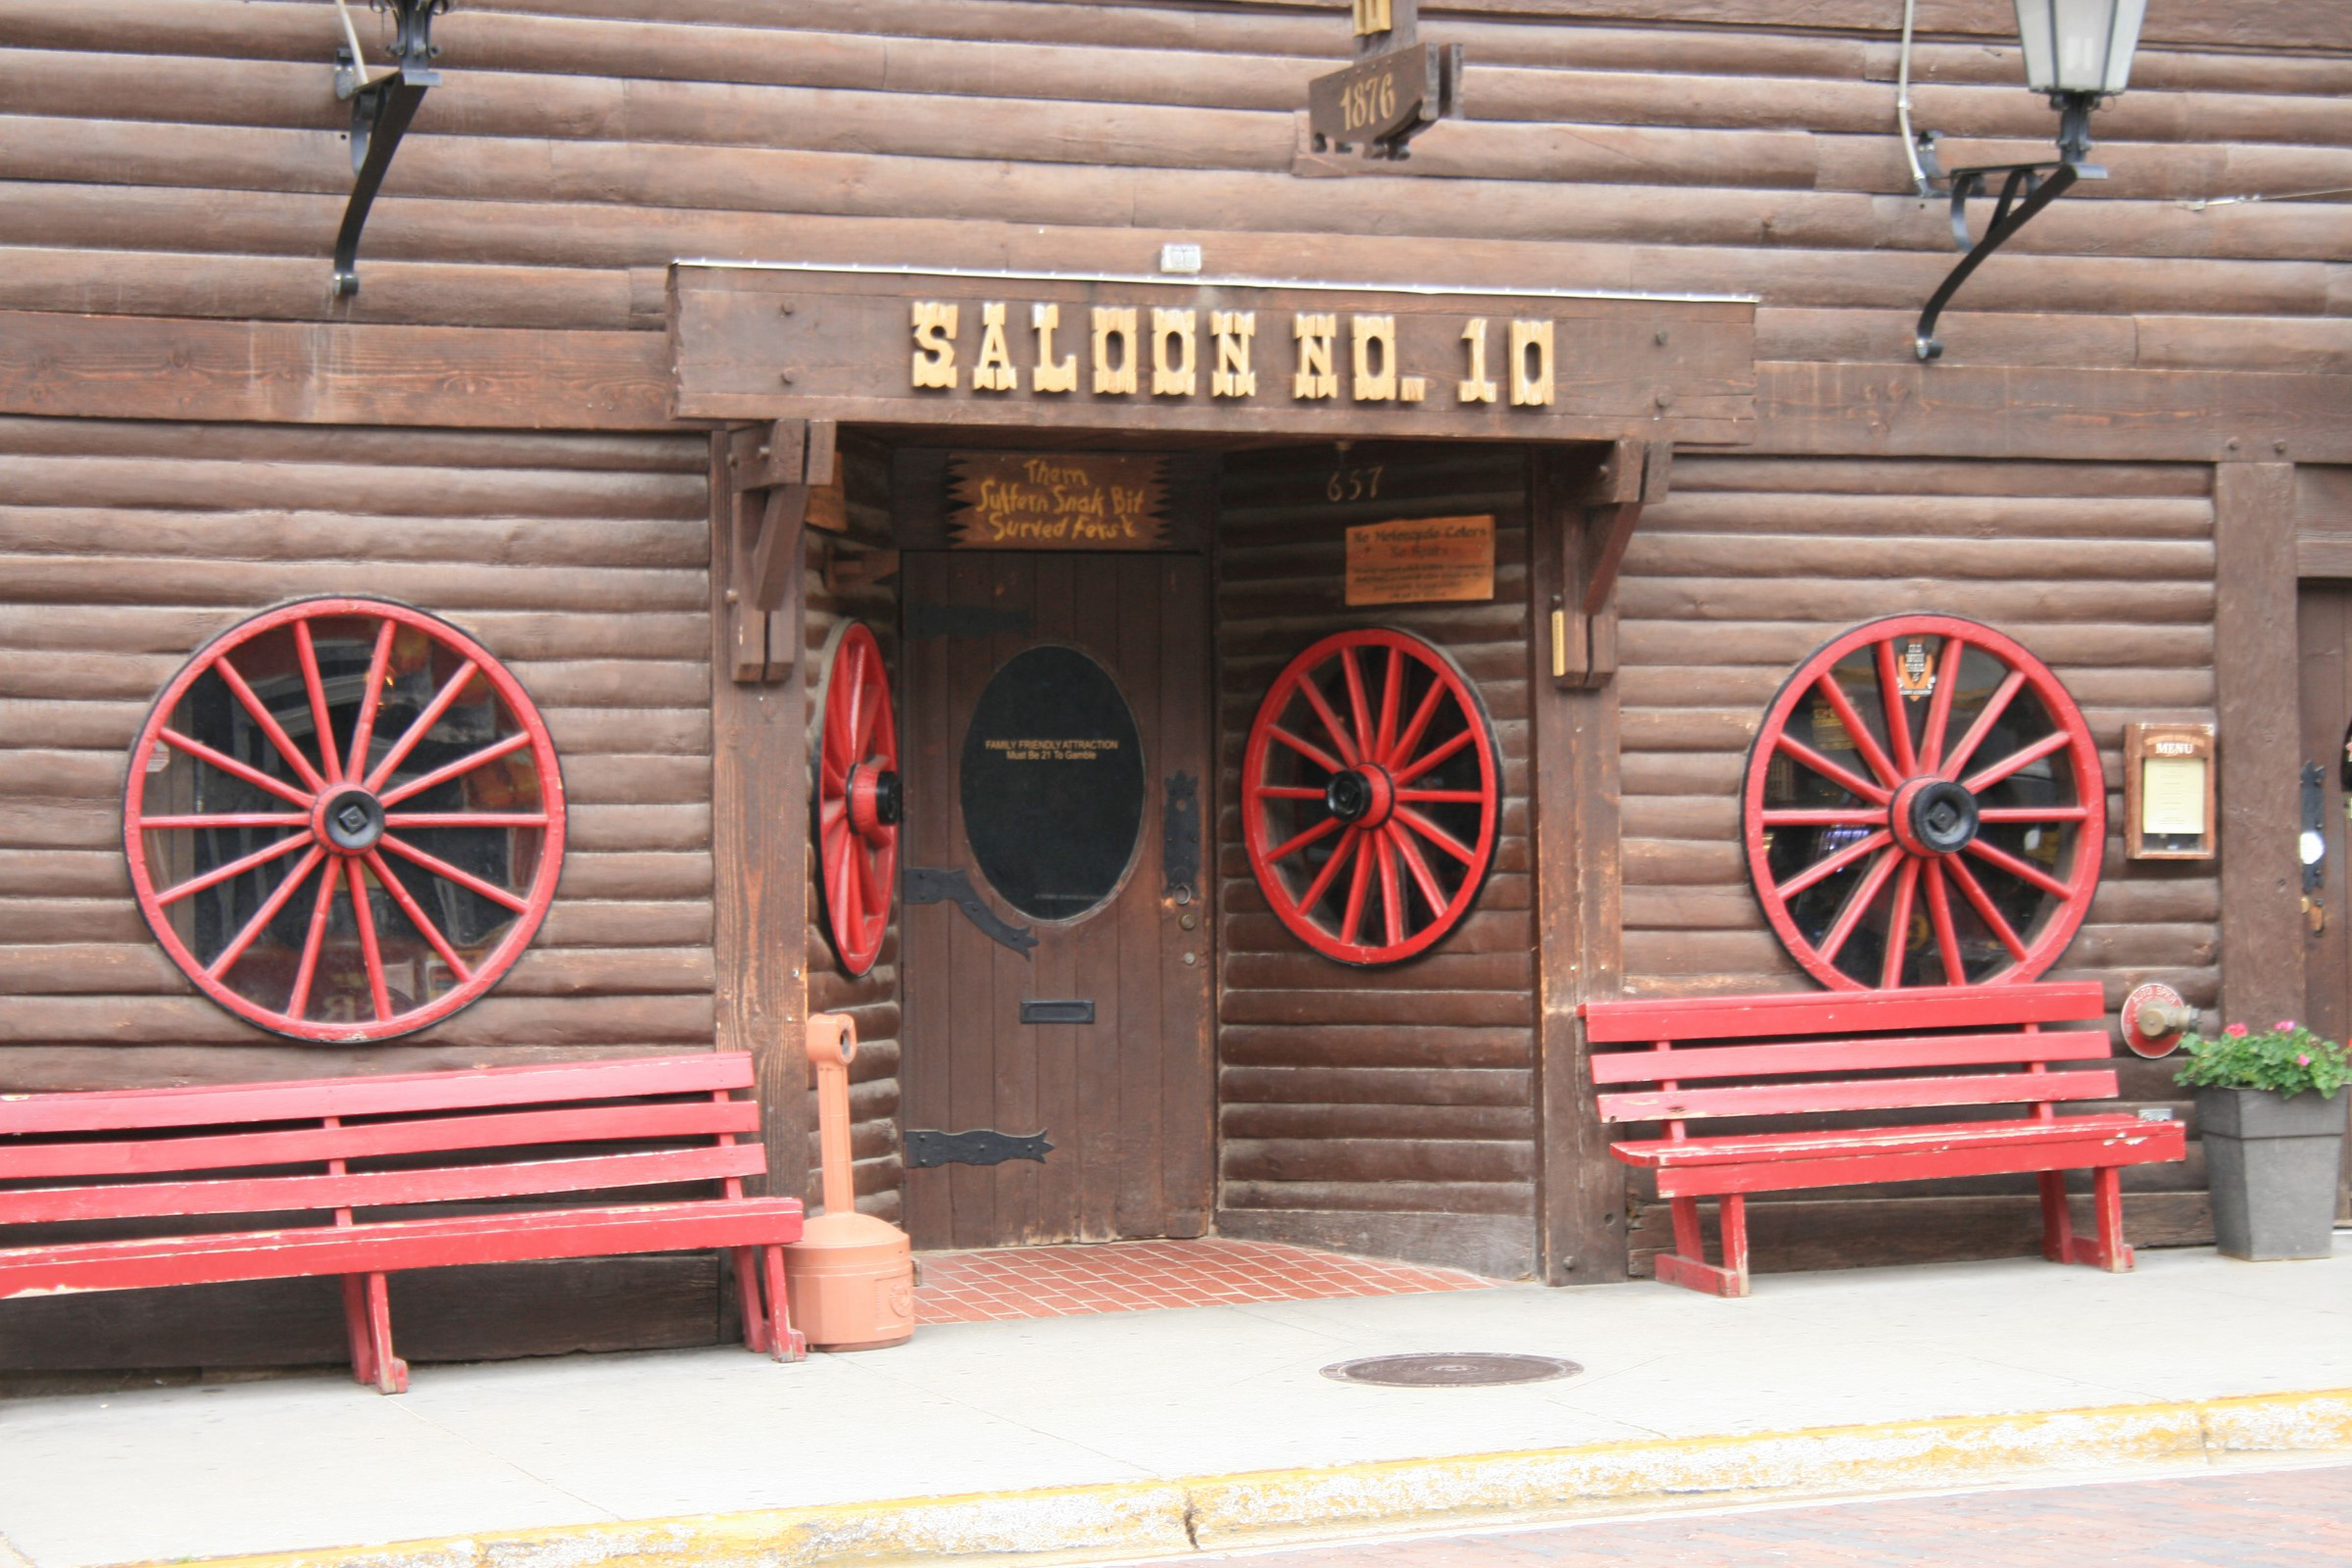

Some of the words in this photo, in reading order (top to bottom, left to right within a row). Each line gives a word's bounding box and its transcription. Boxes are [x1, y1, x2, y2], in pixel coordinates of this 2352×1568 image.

[1340, 73, 1396, 131] 1876
[911, 301, 1256, 398] SALOON
[1294, 313, 1426, 403] NO.
[1458, 318, 1555, 407] 10
[1023, 459, 1089, 486] Them
[1053, 484, 1104, 517] Snak
[1110, 486, 1146, 515] Bit
[988, 512, 1070, 541] Surved
[985, 740, 1016, 750] FAMILY
[1018, 740, 1061, 750] FRIENDLY
[1062, 740, 1119, 750] ATTRACTION
[1006, 751, 1026, 760] Must
[1028, 751, 1039, 760] Be
[1041, 751, 1051, 760] 21
[1054, 751, 1063, 760] To
[1064, 751, 1098, 760] Gamble
[2155, 742, 2194, 755] MENU
[2132, 987, 2152, 1003] AUTO
